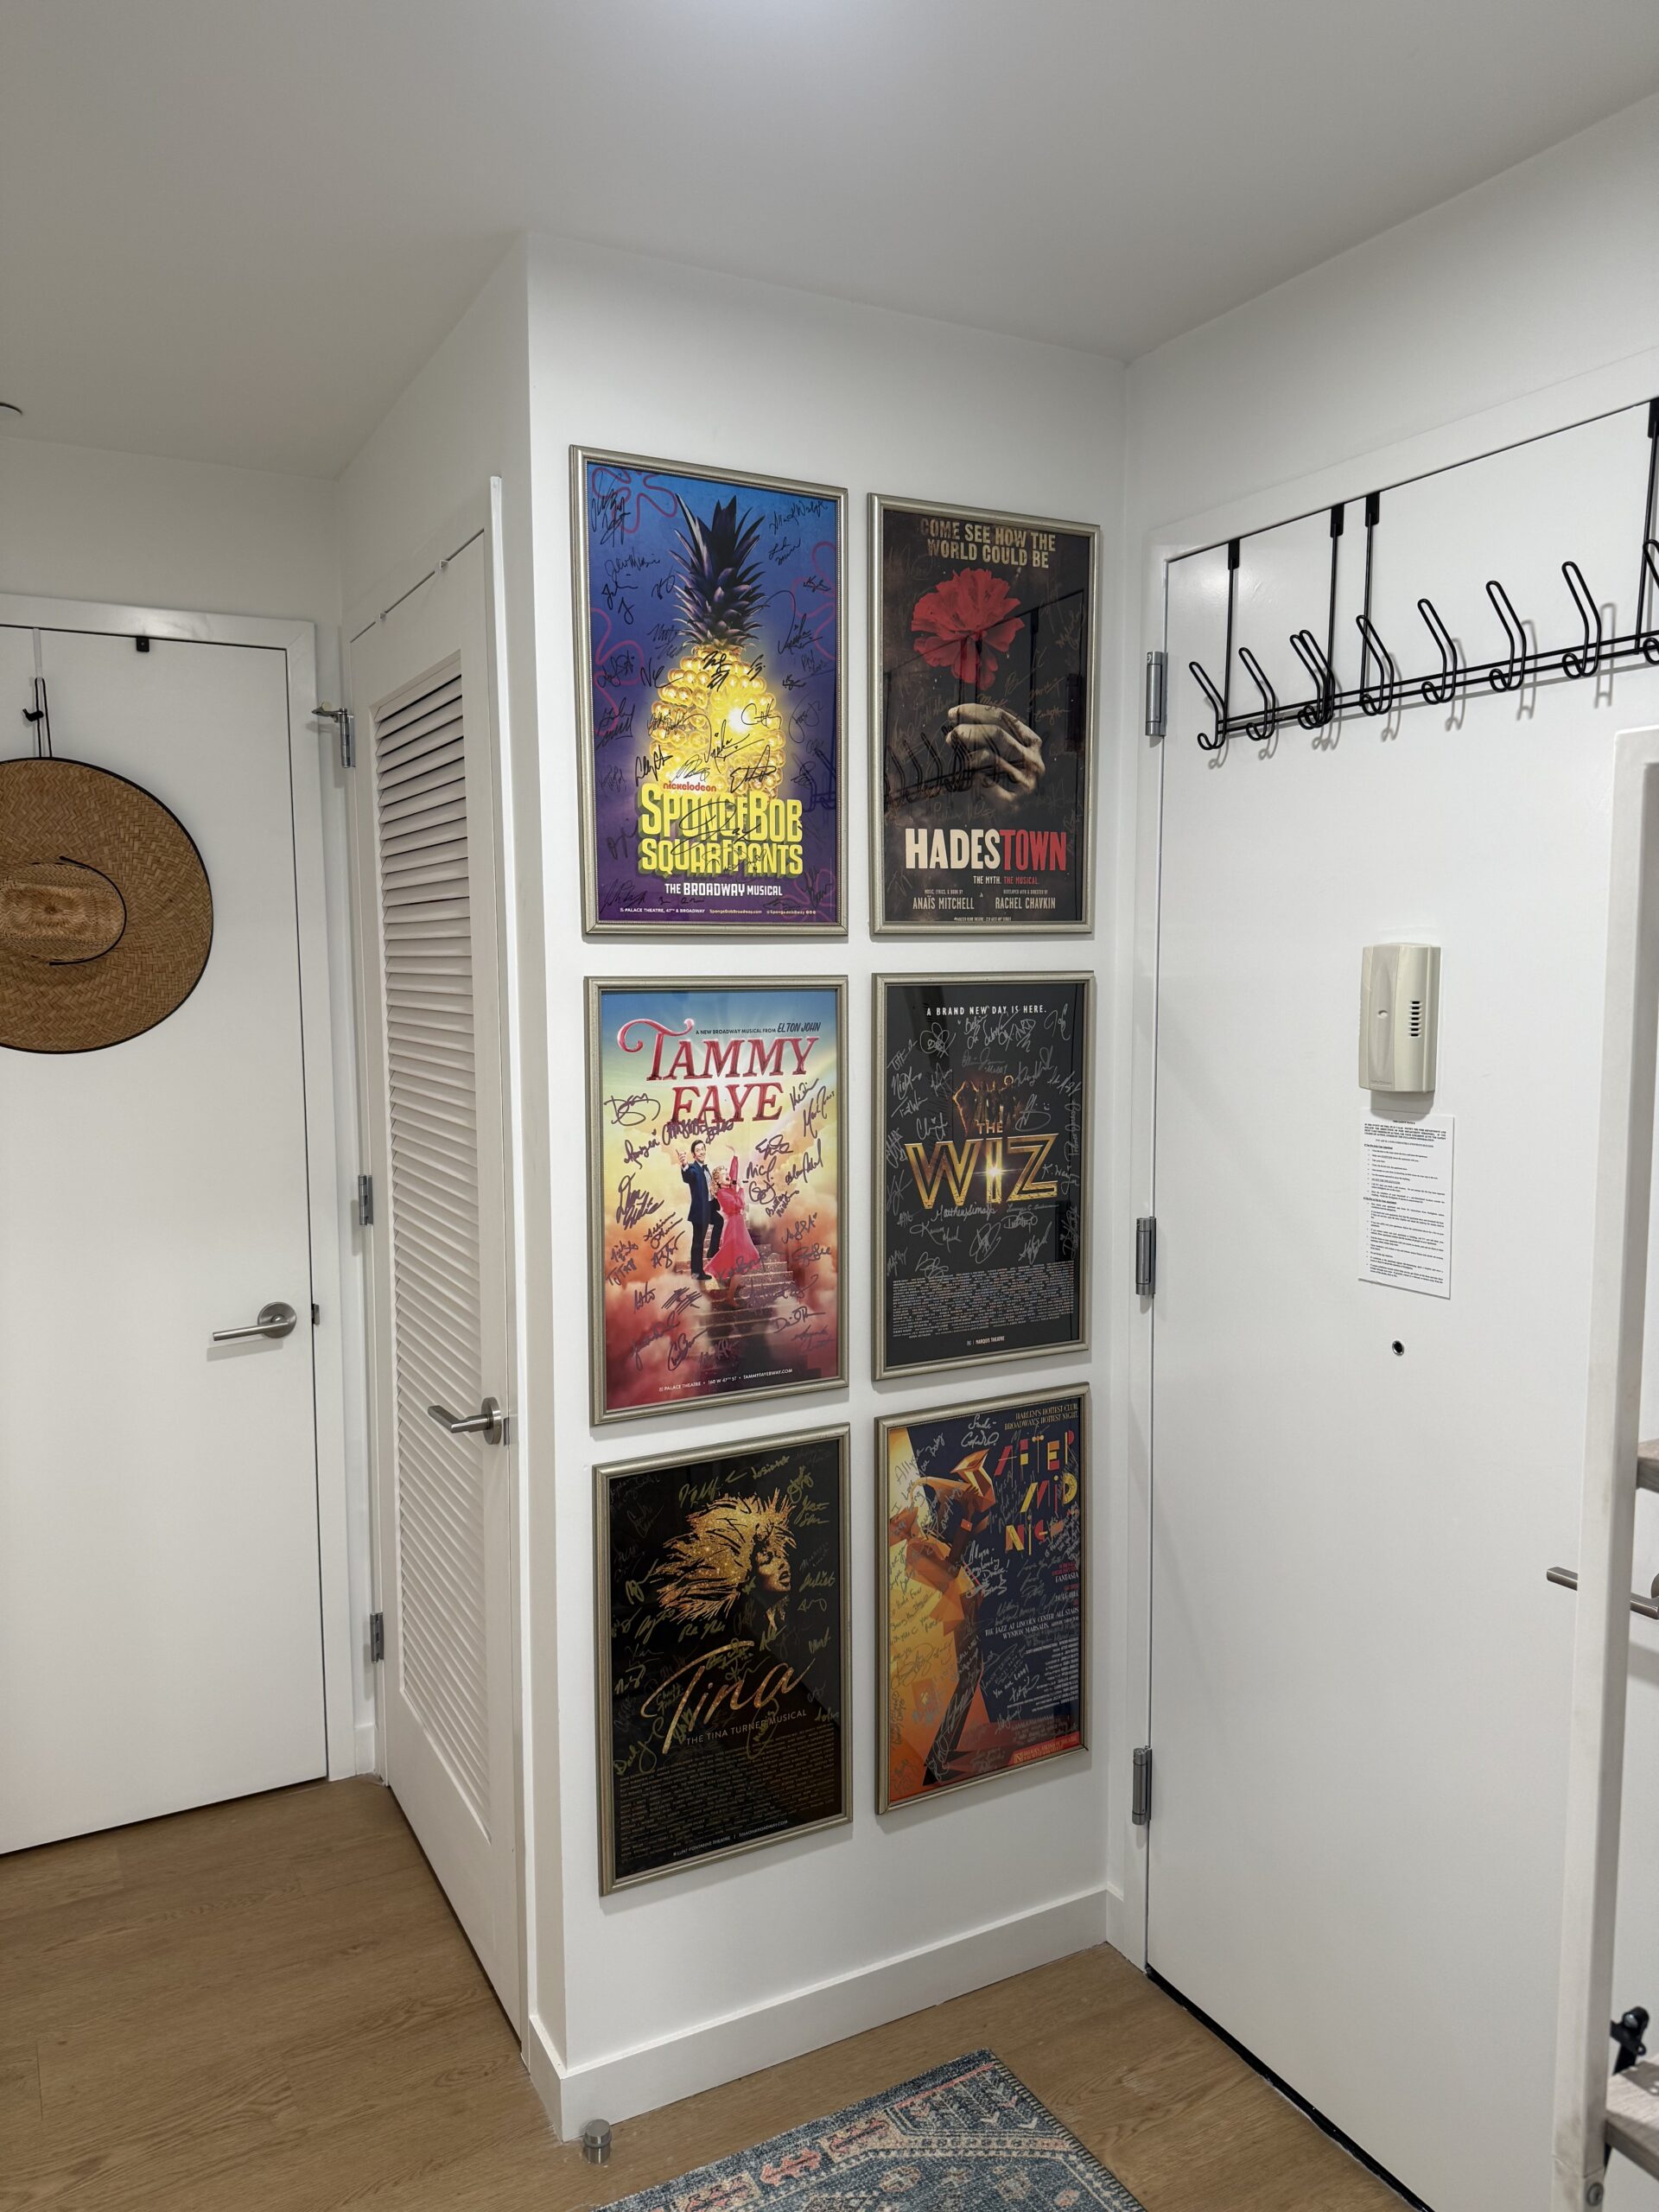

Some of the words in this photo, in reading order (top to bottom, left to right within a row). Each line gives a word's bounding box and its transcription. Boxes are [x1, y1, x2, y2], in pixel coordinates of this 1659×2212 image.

[920, 518, 960, 540] COME
[964, 524, 991, 543] SEE
[995, 527, 1027, 548] HOW
[1031, 531, 1056, 551] THE
[927, 539, 977, 561] WORLD
[982, 544, 1027, 566] COULD
[1032, 550, 1049, 568] BE
[663, 782, 717, 792] nickelodeon
[639, 838, 804, 875] SQUAREPANTS
[973, 875, 984, 885] THE
[985, 875, 1001, 885] MYTH.
[1003, 876, 1014, 885] THE
[664, 883, 681, 894] THE
[683, 882, 746, 896] BROADWAY
[747, 885, 783, 896] MUSICAL
[912, 895, 936, 910] ANAÏS
[938, 897, 975, 910] MITCHELL
[995, 897, 1022, 910] RACHEL
[1025, 897, 1056, 910] CHAVKIN
[926, 1007, 931, 1016] A
[937, 1007, 965, 1016] BRAND
[969, 1007, 987, 1015] NEW
[992, 1006, 1007, 1014] DAY
[1023, 1005, 1047, 1014] HERE.
[778, 1022, 800, 1033] ELTON
[801, 1022, 821, 1032] JOHN
[617, 1018, 820, 1081] TAMMY
[667, 1082, 784, 1124] FAYE
[976, 1120, 1003, 1134] THE
[904, 1133, 1059, 1210] WIZ
[1043, 1406, 1064, 1414] HOTTEST
[1040, 1414, 1062, 1424] HOTTEST
[995, 1625, 1007, 1635] JAZZ
[1016, 1618, 1037, 1628] LINCOLN
[1038, 1612, 1054, 1622] CENTER
[1002, 1630, 1024, 1639] WYNTON
[640, 1640, 816, 1755] Tina
[686, 1734, 704, 1745] THE
[706, 1729, 729, 1742] TINA
[731, 1719, 767, 1734] TURNER
[768, 1709, 807, 1725] MUSICAL
